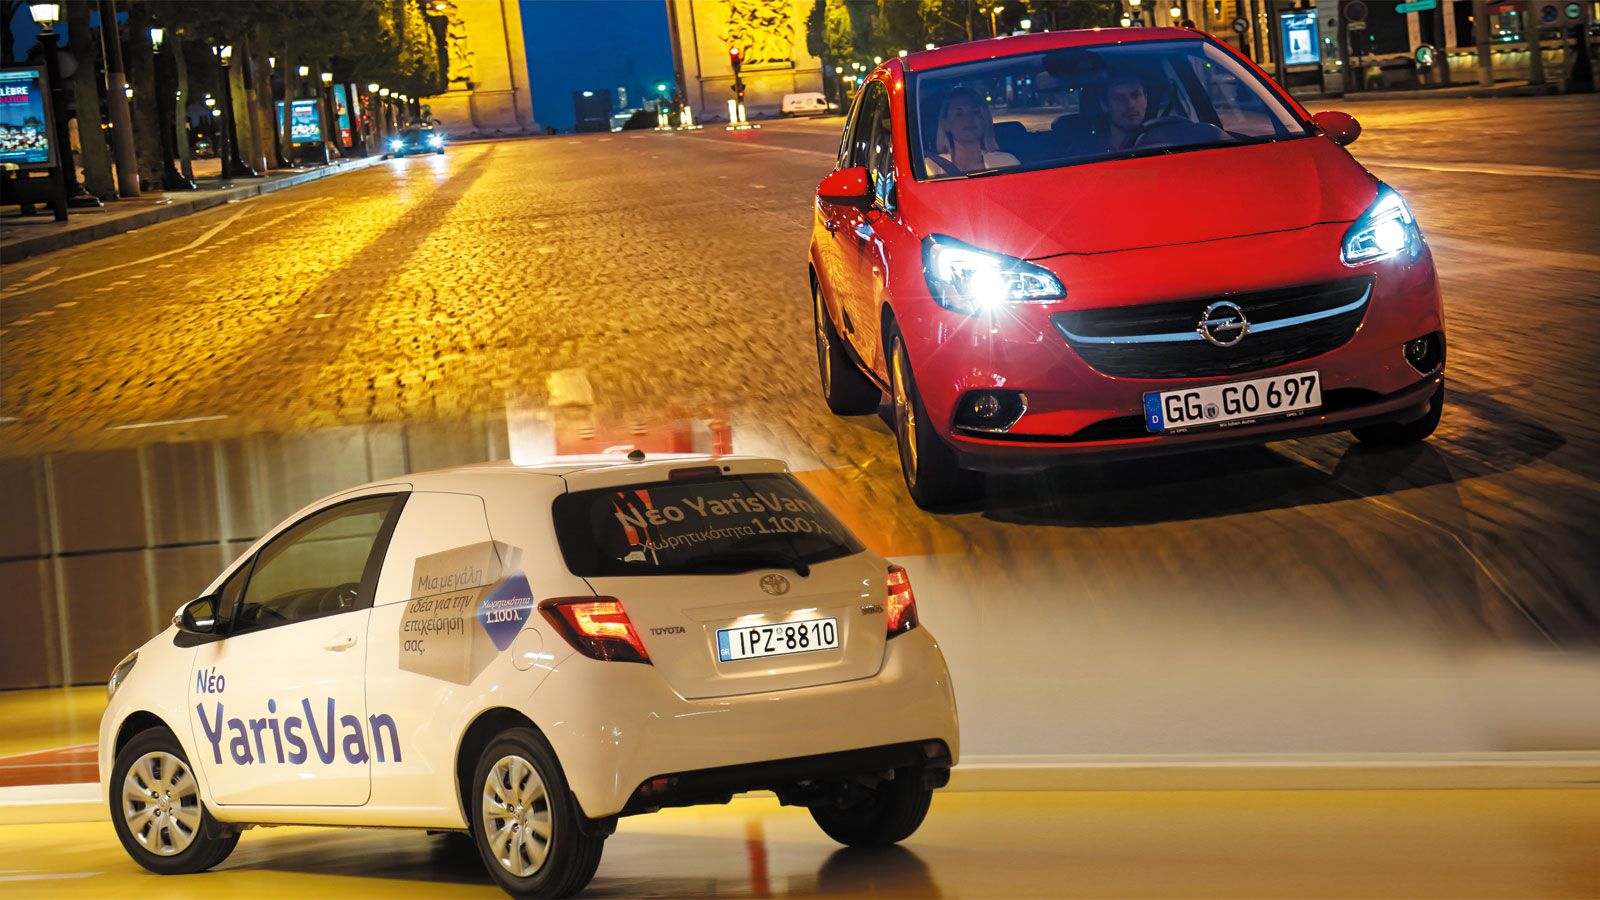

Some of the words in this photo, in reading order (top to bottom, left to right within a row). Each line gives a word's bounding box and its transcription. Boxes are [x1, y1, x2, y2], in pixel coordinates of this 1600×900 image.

[0, 85, 29, 97] LÈBRE
[1165, 392, 1204, 423] GG
[1222, 384, 1260, 415] GO
[1266, 375, 1317, 409] 697
[1152, 415, 1159, 424] D
[682, 492, 818, 518] YarisVan
[752, 515, 811, 534] 1.100
[417, 575, 439, 591] Μια
[440, 566, 483, 592] μεγάλη
[410, 597, 432, 614] ιδέα
[434, 598, 452, 616] για
[452, 594, 474, 614] την
[486, 609, 512, 624] 1.100
[649, 626, 686, 636] TOYOTA
[404, 639, 426, 655] σας.
[720, 648, 730, 657] GR
[196, 666, 226, 694] Νέο
[196, 696, 403, 766] YarisVan
